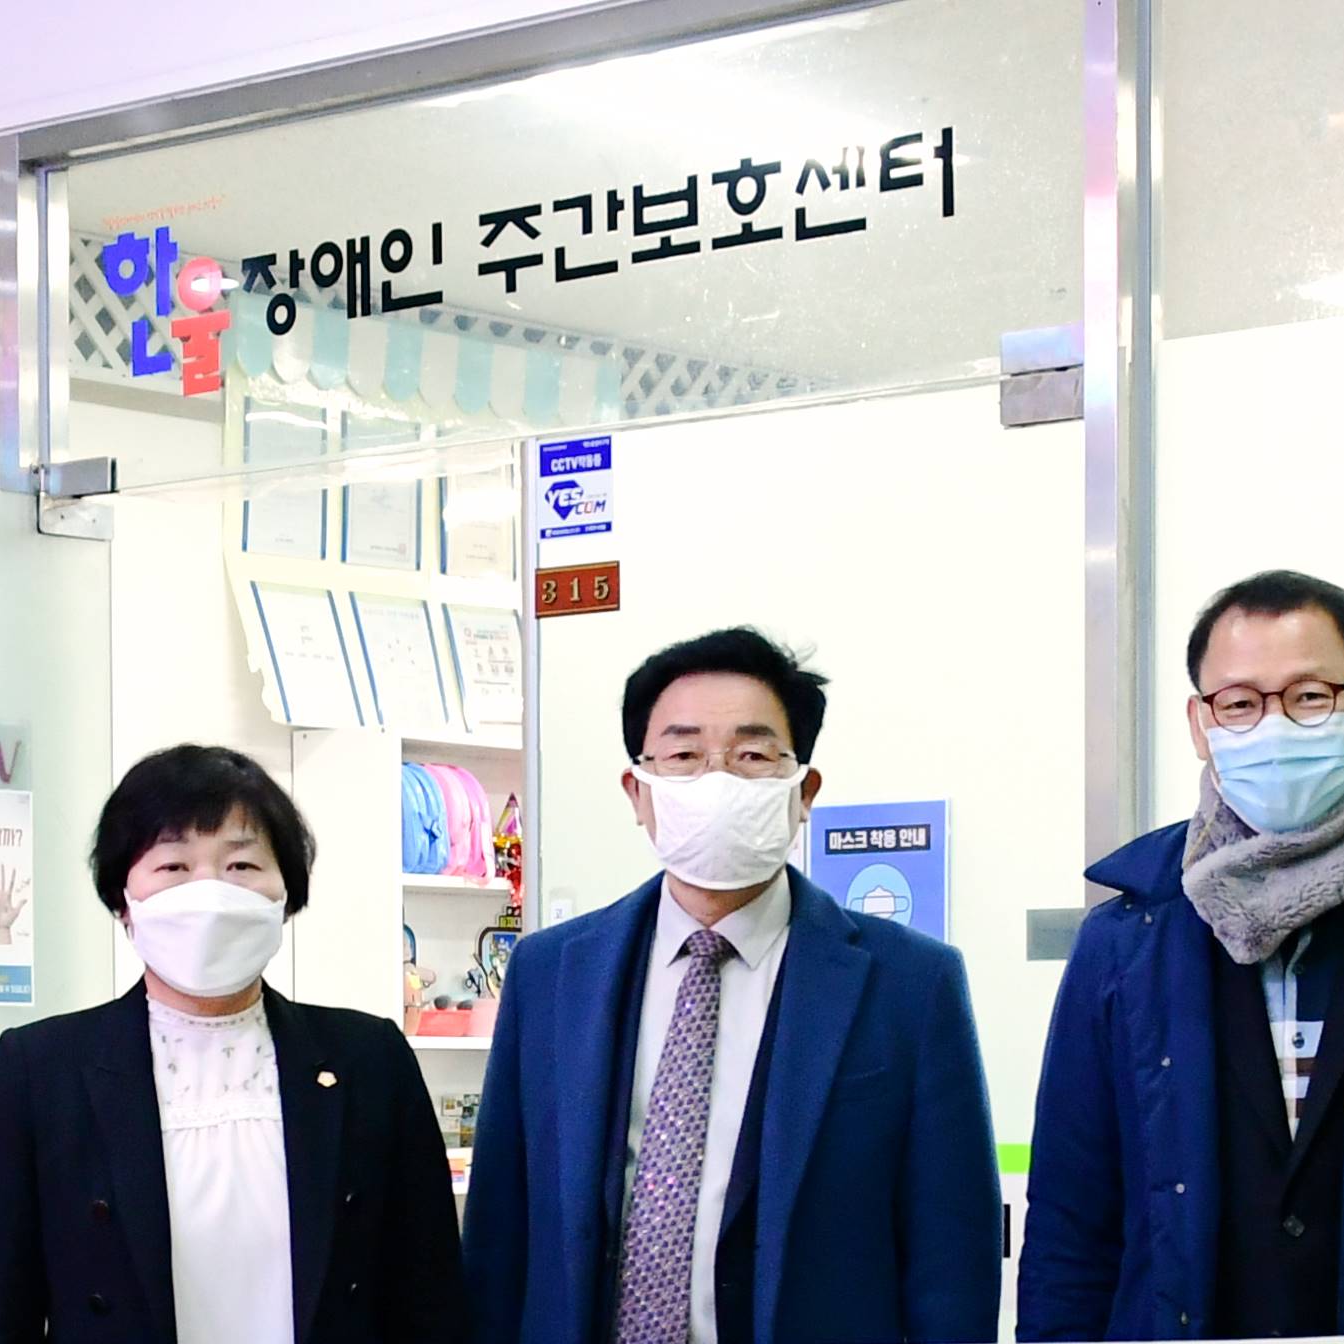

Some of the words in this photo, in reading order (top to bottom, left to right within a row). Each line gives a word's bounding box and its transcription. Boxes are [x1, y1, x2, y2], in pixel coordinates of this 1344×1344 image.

[102, 225, 233, 397] 한울
[241, 222, 443, 336] 장애인
[477, 126, 955, 294] 주간보호센터
[546, 486, 583, 508] YES
[541, 576, 610, 604] 315
[829, 831, 868, 850] 마스크
[870, 829, 897, 849] 착용
[899, 828, 927, 848] 안내
